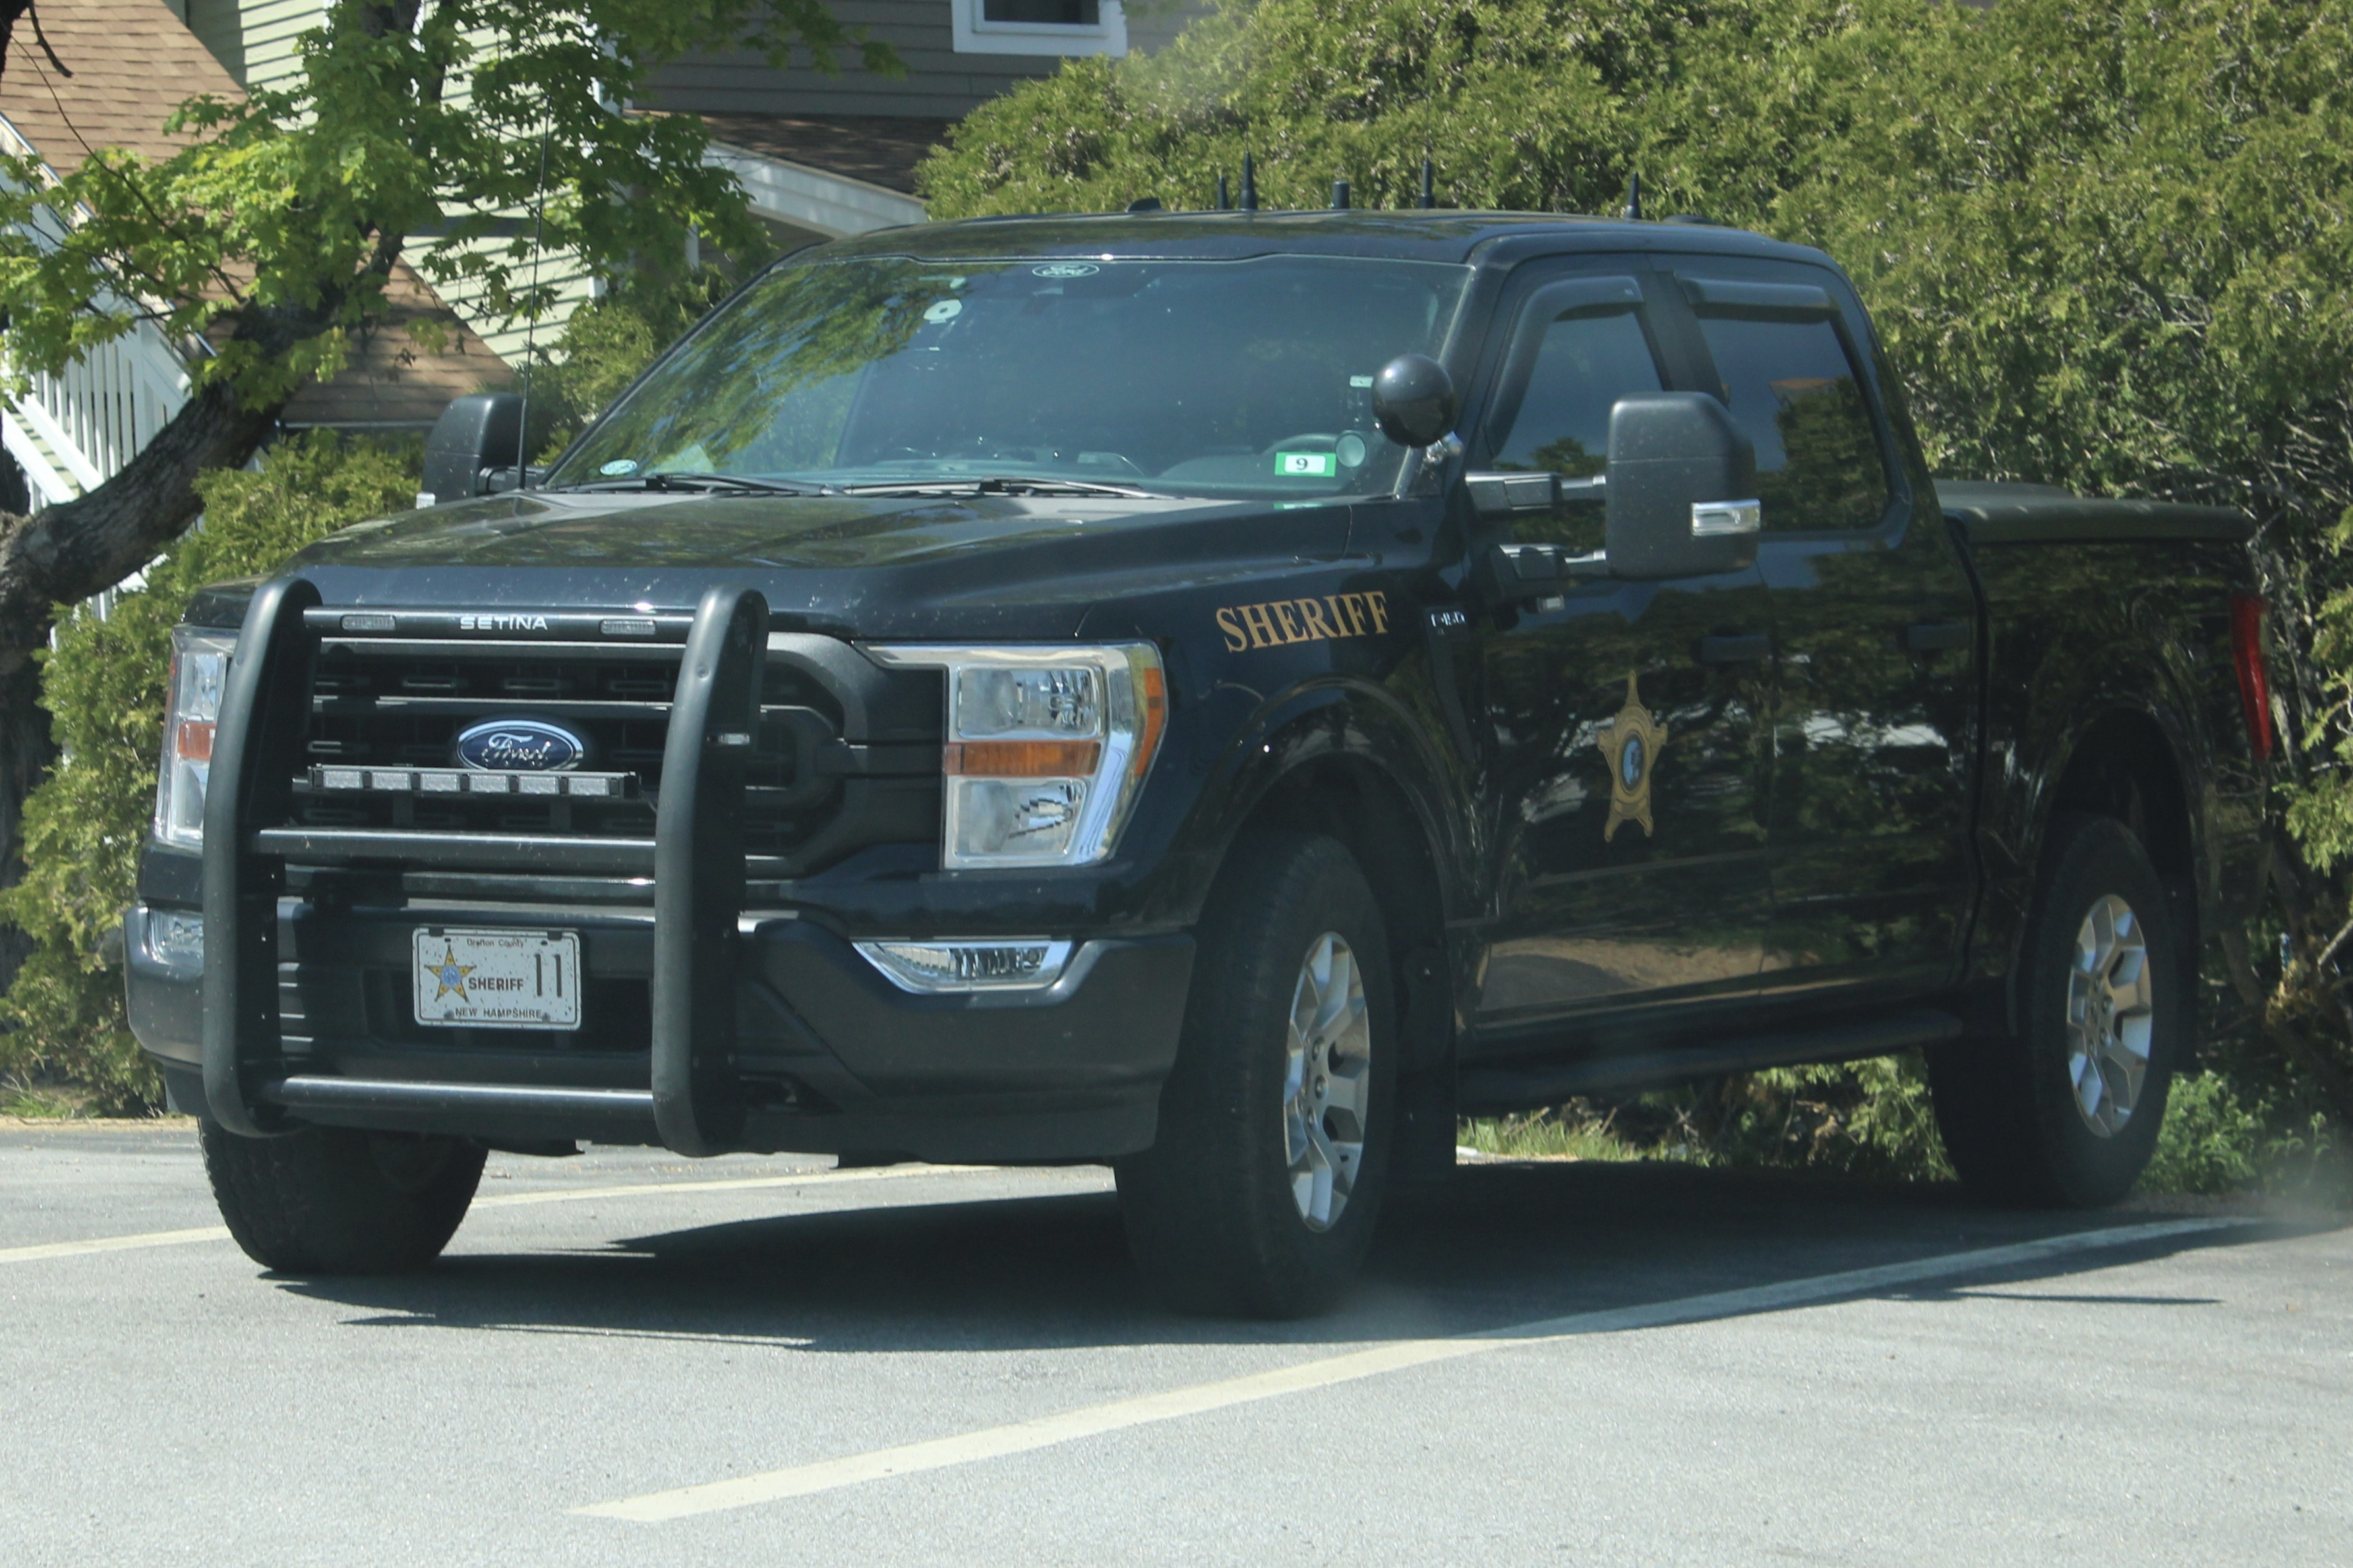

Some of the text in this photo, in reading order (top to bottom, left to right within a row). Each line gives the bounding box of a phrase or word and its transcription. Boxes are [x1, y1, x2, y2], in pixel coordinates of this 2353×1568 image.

[1296, 458, 1309, 471] 9
[460, 616, 549, 631] SETINA
[1216, 591, 1388, 654] SHERIFF
[481, 732, 552, 769] Ford
[498, 938, 524, 948] County
[535, 953, 562, 998] 11
[468, 977, 524, 992] SHERIFF
[455, 1007, 542, 1020] NEW HAMPSHIRE
